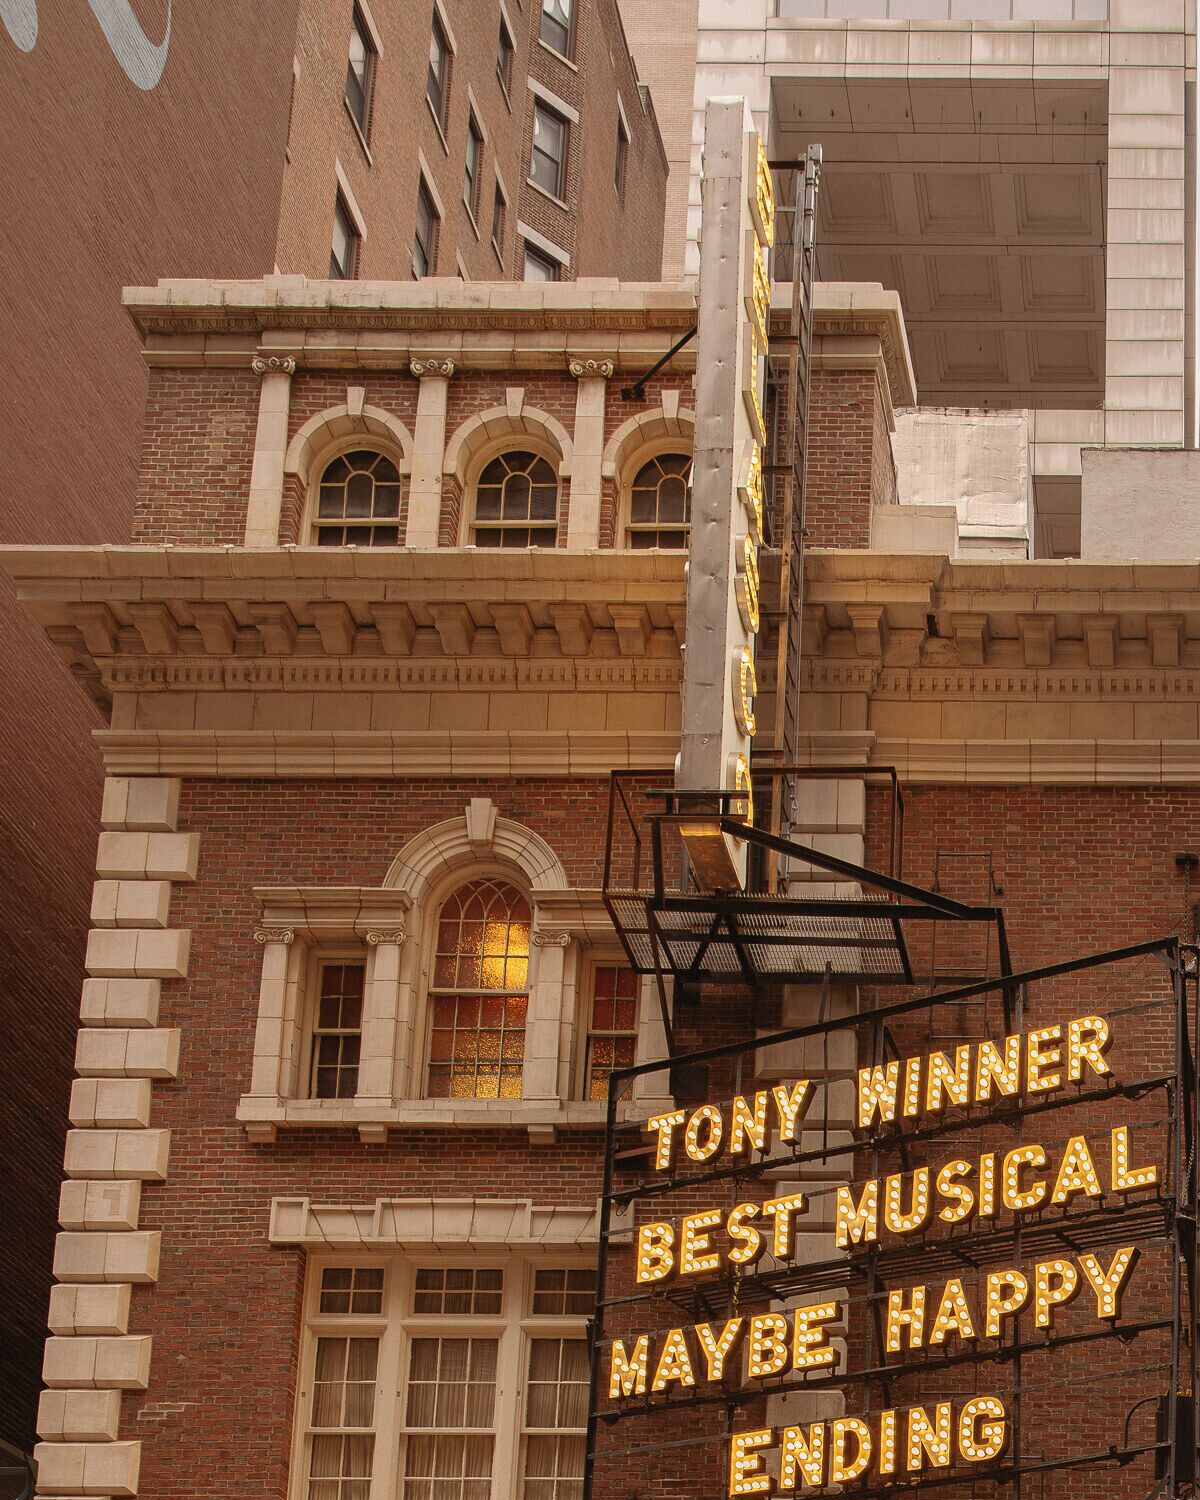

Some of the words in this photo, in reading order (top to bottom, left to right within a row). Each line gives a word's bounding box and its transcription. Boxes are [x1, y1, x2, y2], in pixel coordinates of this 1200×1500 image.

[647, 1079, 816, 1171] TONY
[857, 1015, 1115, 1129] WINNER
[636, 1193, 809, 1285] BEST
[835, 1125, 1159, 1251] MUSICAL
[608, 1301, 842, 1399] MAYBE
[886, 1246, 1142, 1353] HAPPY
[729, 1396, 1007, 1498] ENDING
